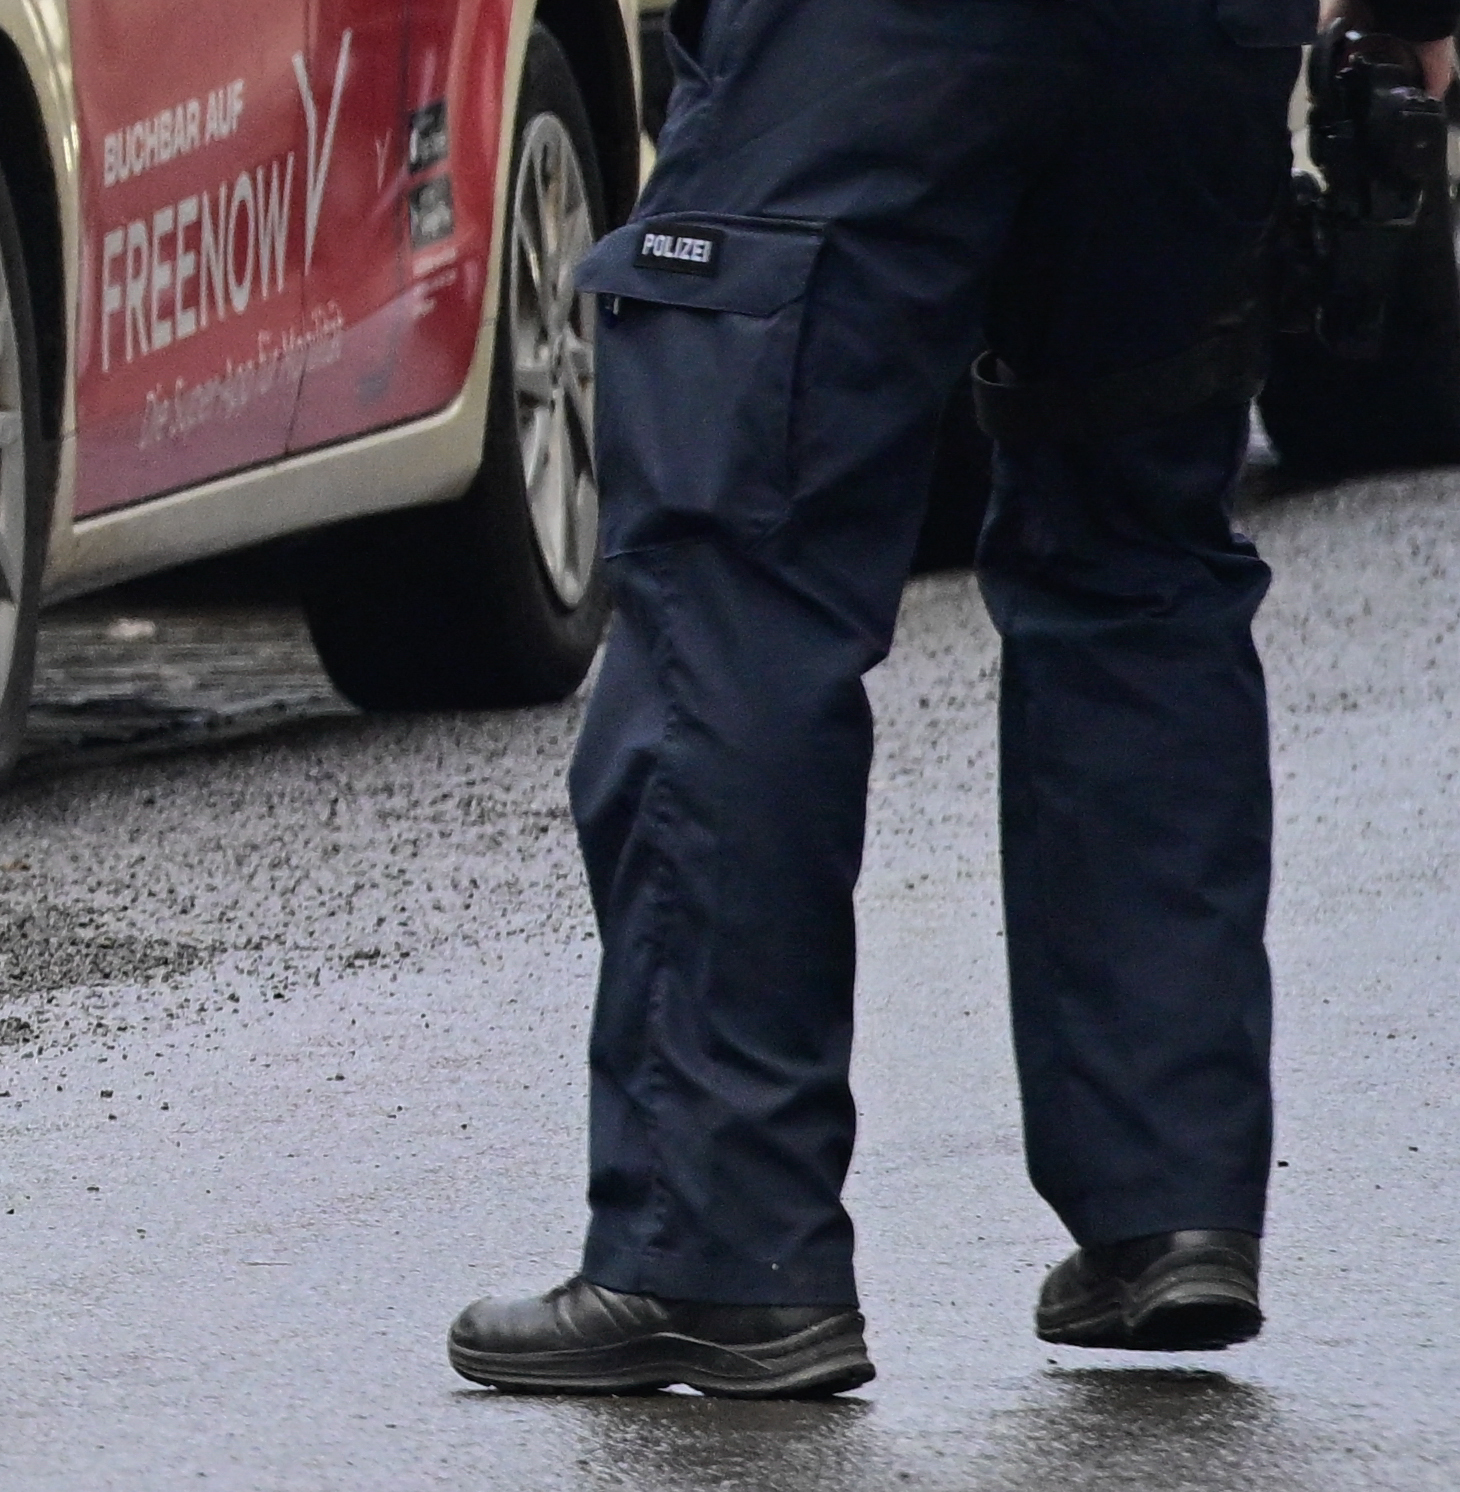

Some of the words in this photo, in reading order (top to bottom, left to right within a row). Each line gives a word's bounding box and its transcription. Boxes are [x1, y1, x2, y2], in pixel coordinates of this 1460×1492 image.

[103, 97, 202, 189] BUCHBAR
[204, 78, 246, 147] AUF
[101, 151, 296, 374] FREENOW
[641, 233, 713, 264] POLIZEI
